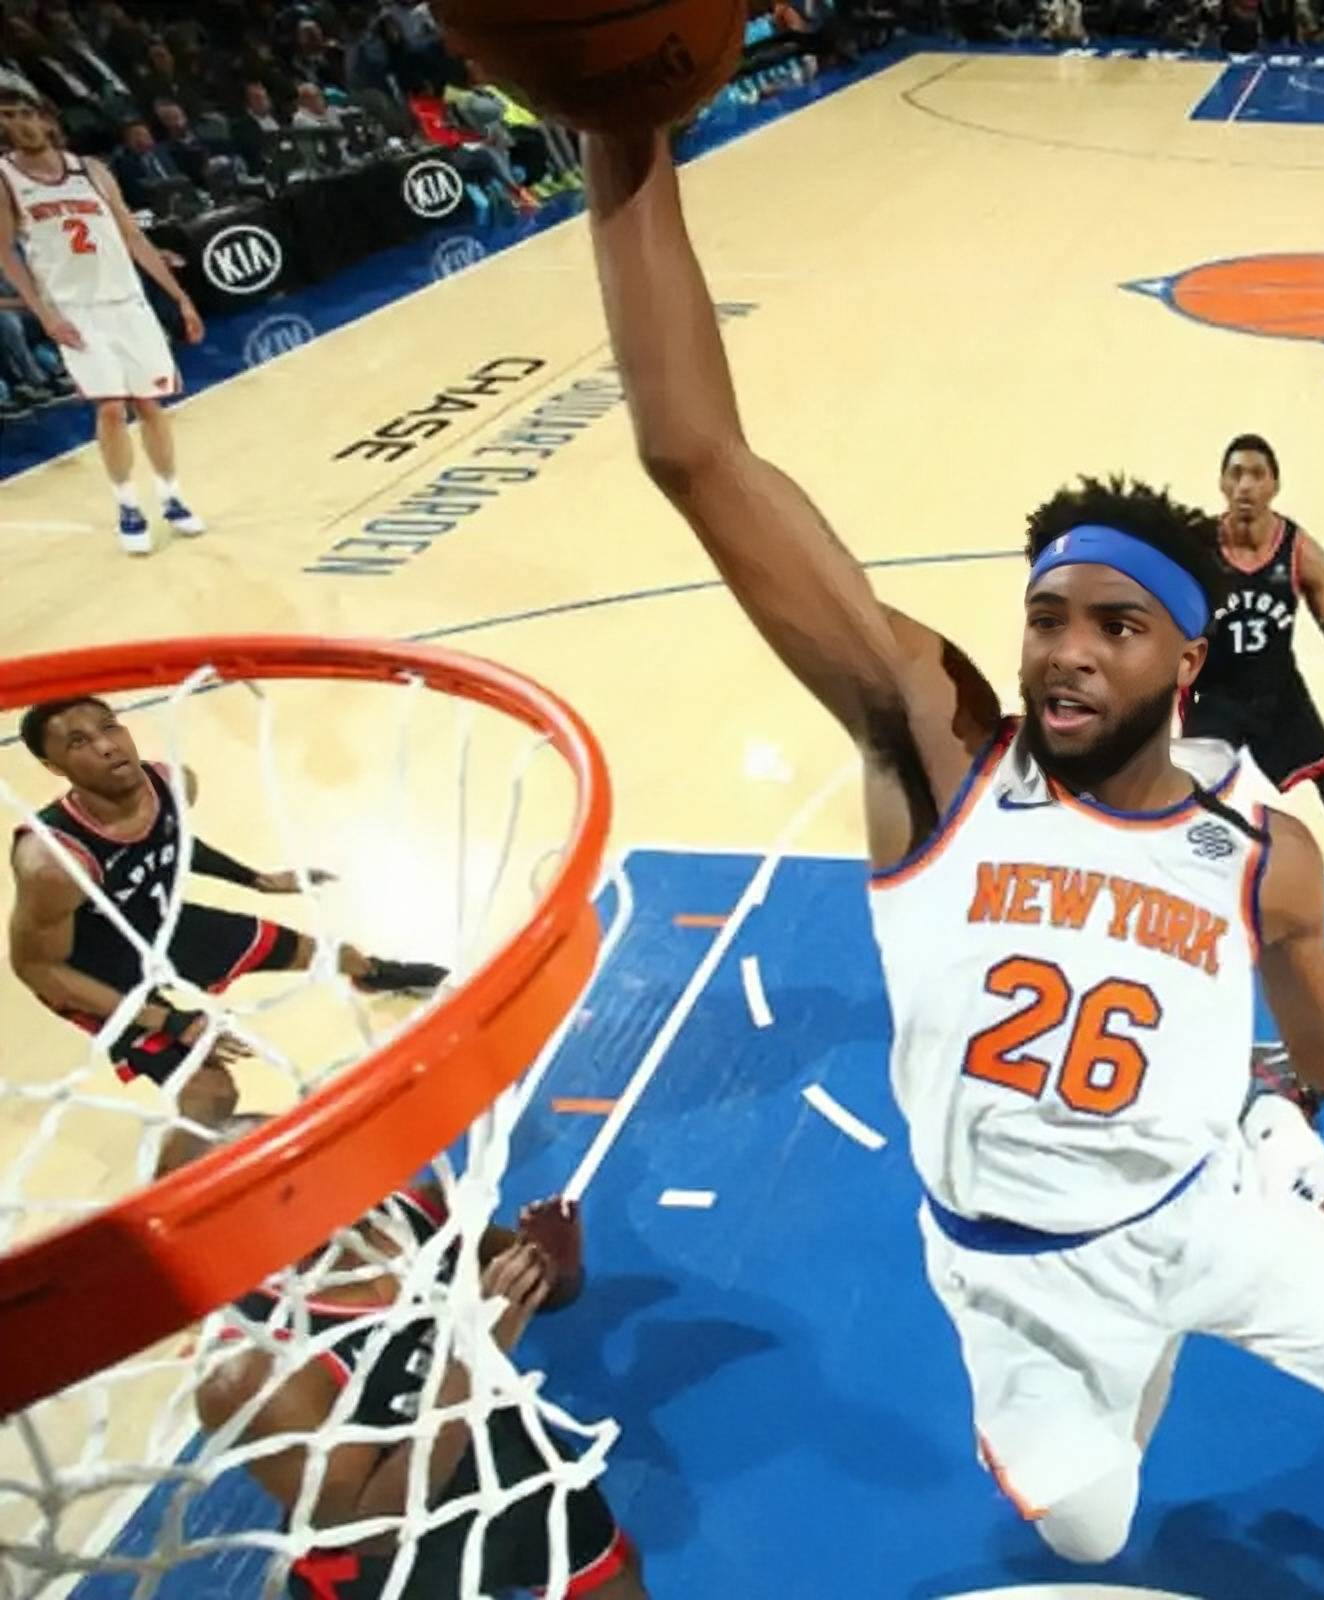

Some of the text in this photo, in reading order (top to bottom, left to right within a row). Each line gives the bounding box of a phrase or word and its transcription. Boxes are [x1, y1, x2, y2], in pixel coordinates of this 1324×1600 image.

[409, 170, 456, 208] KIA
[62, 219, 97, 254] 2
[213, 236, 272, 284] KIA
[332, 356, 547, 463] CHASE
[302, 465, 540, 576] GARDEN
[1228, 618, 1268, 654] 13
[967, 862, 1230, 977] NEW YORK
[961, 953, 1163, 1118] 26
